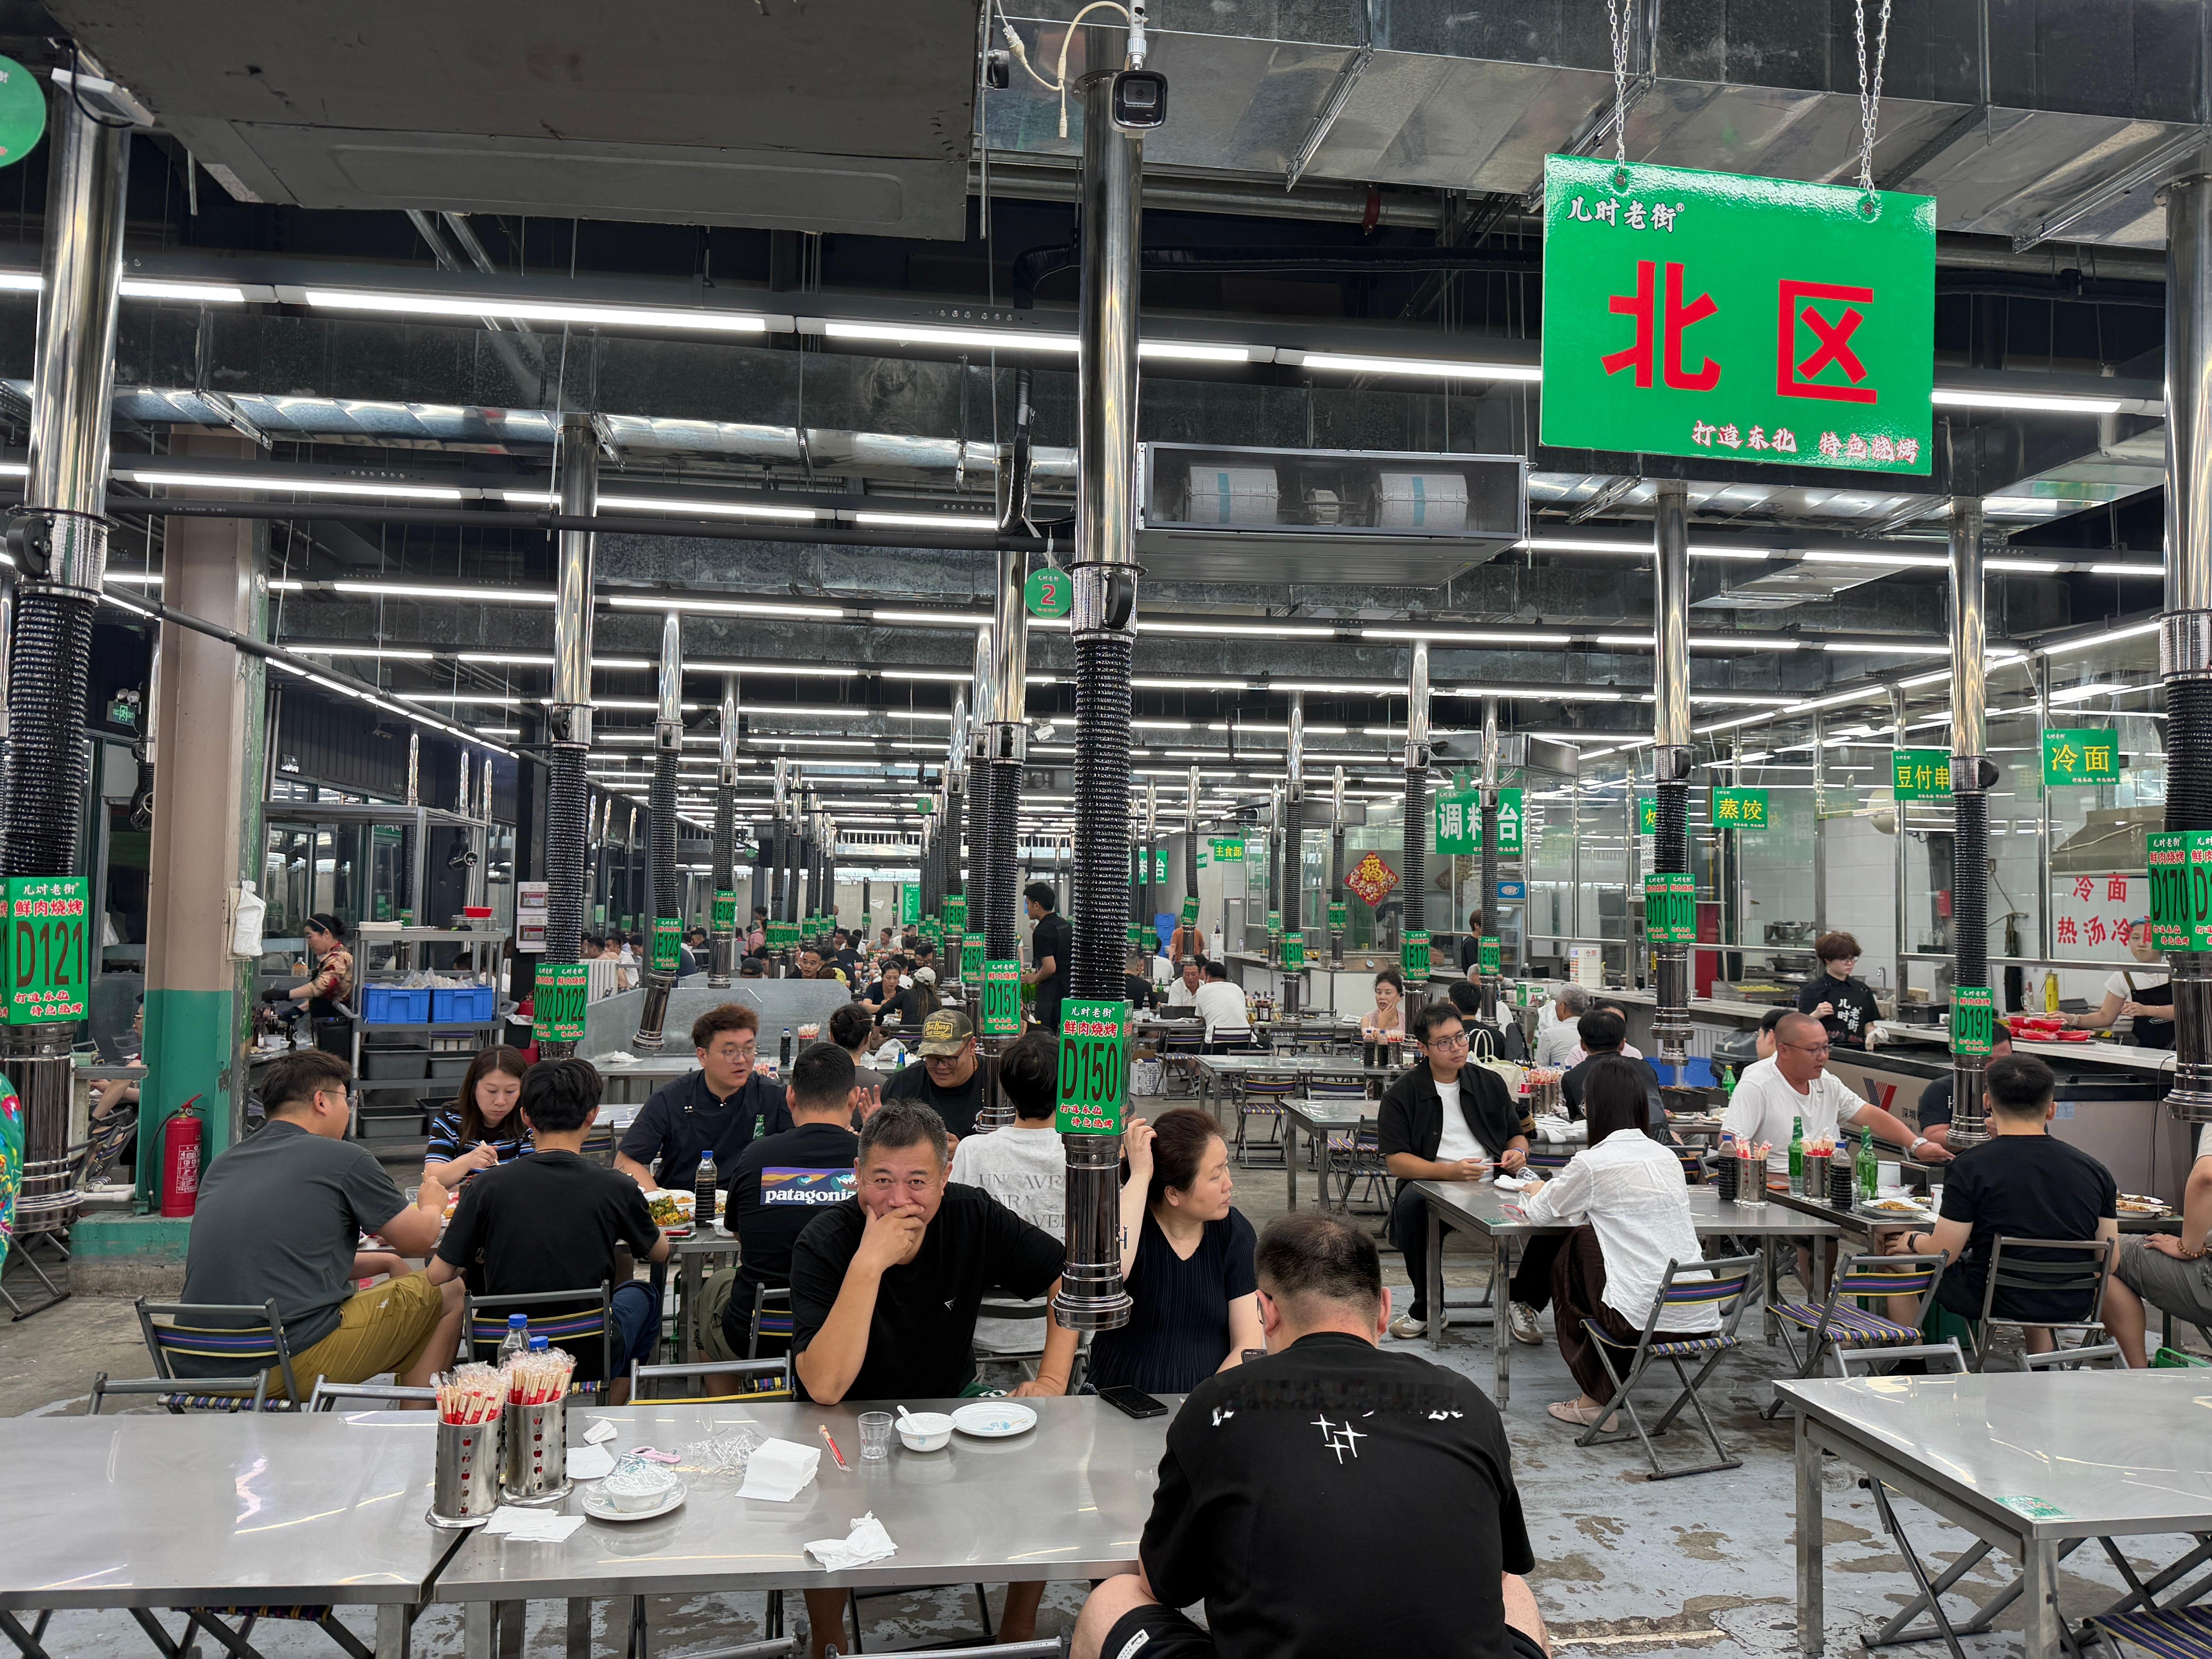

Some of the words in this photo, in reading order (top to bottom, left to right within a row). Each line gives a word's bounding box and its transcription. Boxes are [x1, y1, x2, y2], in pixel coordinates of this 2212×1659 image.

[1566, 195, 1677, 233] 儿时老街
[1600, 260, 1877, 405] 北区
[1691, 420, 1798, 453] 打造东北
[1818, 431, 1920, 465] 特色烧烤
[1041, 584, 1055, 605] 2
[2051, 744, 2110, 772] 冷面
[1896, 765, 1949, 790] 豆付串
[1718, 799, 1762, 820] 蒸饺
[1215, 845, 1242, 857] 主食部
[2150, 850, 2185, 864] 鲜肉烧烤
[23, 884, 76, 895] 儿时老街
[2073, 875, 2128, 902] 冷面
[2152, 868, 2188, 921] D170
[14, 899, 84, 917] 鲜肉烧烤
[718, 902, 733, 920] E125
[950, 906, 964, 924] E153
[1647, 895, 1667, 925] D171
[1671, 894, 1693, 925] D171
[16, 921, 82, 988] D121
[657, 934, 679, 957] E123
[1410, 945, 1429, 967] E172
[1483, 947, 1498, 965] E193
[963, 948, 980, 970] E152
[14, 990, 70, 1003] 打造东北
[534, 986, 553, 1022] D122
[556, 988, 585, 1022] D122
[988, 982, 1017, 1015] D151
[30, 1003, 83, 1017] 特色烧烤
[1071, 1007, 1112, 1018] 儿时老街
[1063, 1020, 1118, 1038] 鲜肉烧烤
[1960, 1007, 1989, 1038] D191
[1062, 1039, 1118, 1102] D150
[1060, 1103, 1103, 1115] 打造东北
[1902, 1107, 1919, 1120] 深圳
